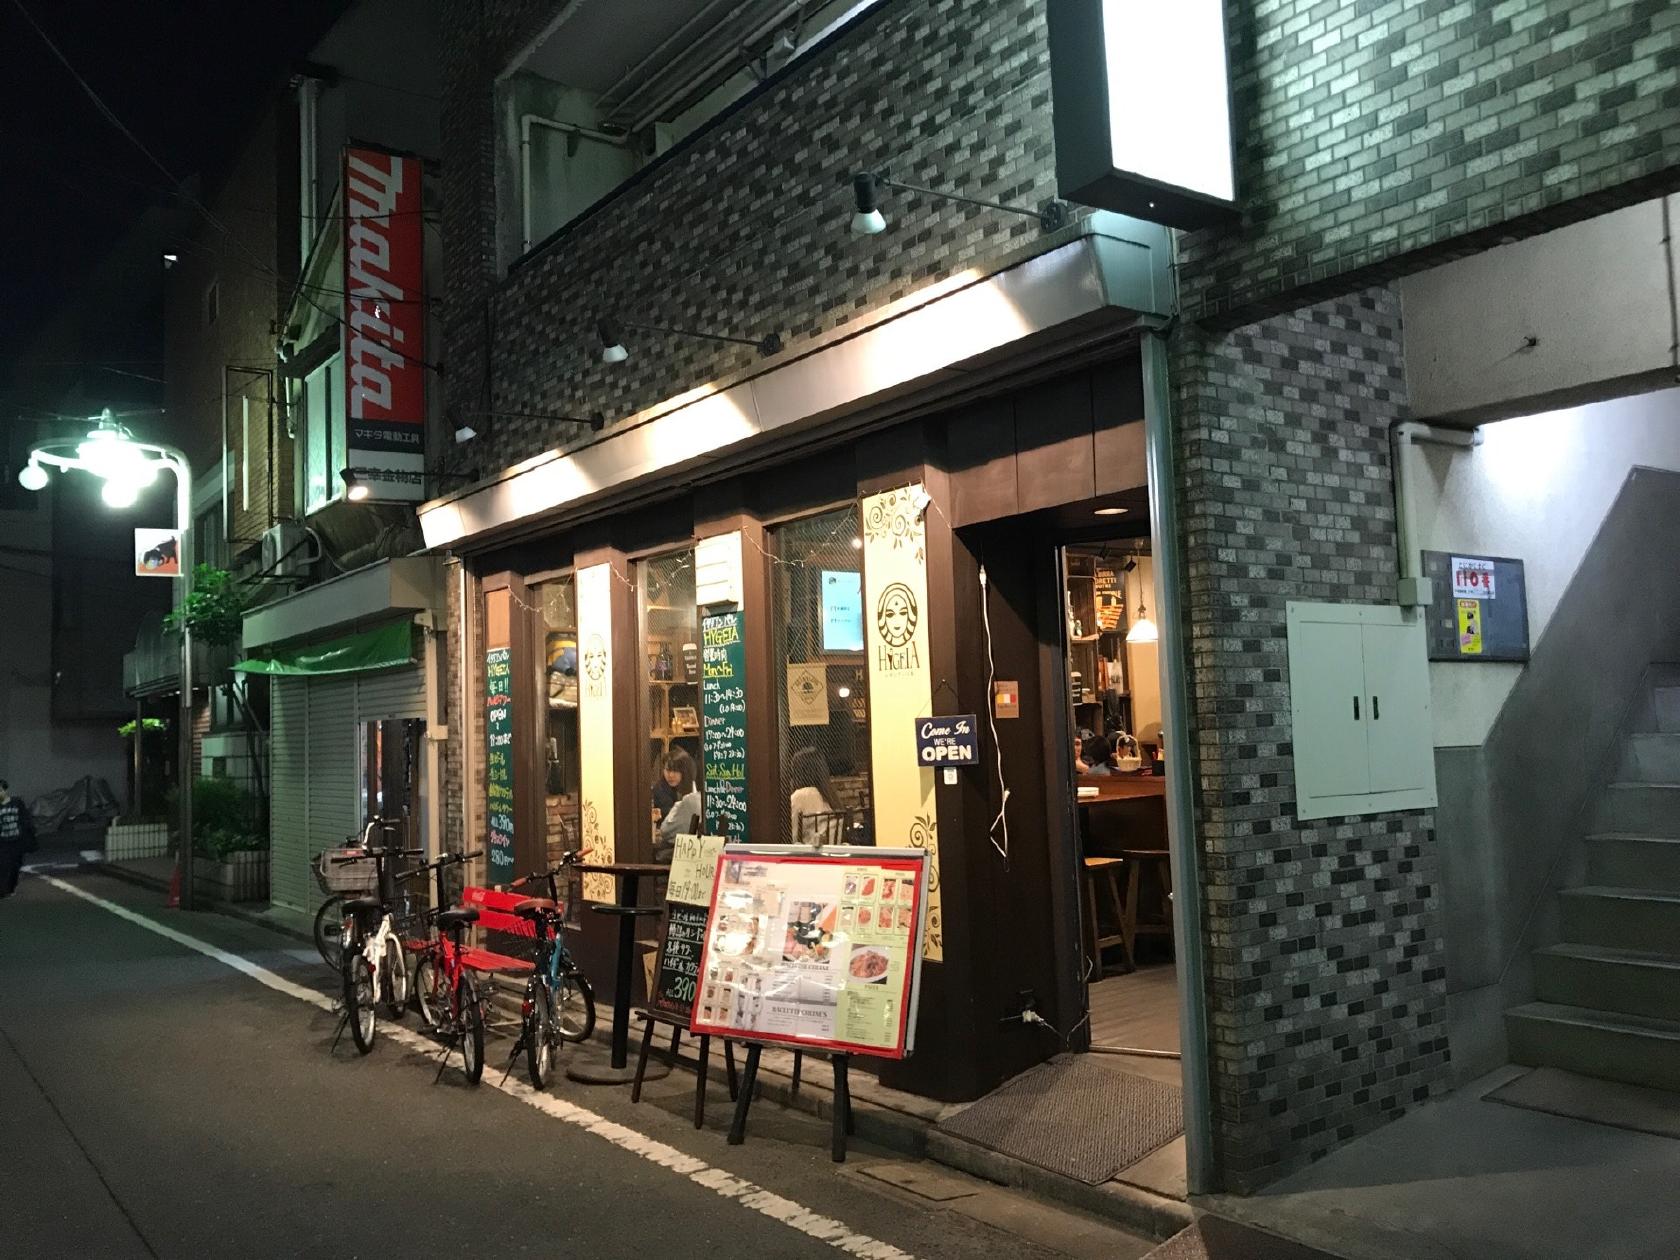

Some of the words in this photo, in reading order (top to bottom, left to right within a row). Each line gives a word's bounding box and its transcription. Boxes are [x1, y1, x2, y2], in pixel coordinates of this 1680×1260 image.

[354, 429, 420, 444] マキタ電動工具
[921, 722, 951, 739] Come
[954, 720, 970, 735] In
[934, 738, 956, 746] WE'RE
[922, 745, 972, 761] OPEN
[675, 837, 706, 859] HAPPY
[696, 864, 715, 879] HOUR
[674, 976, 697, 1002] 390
